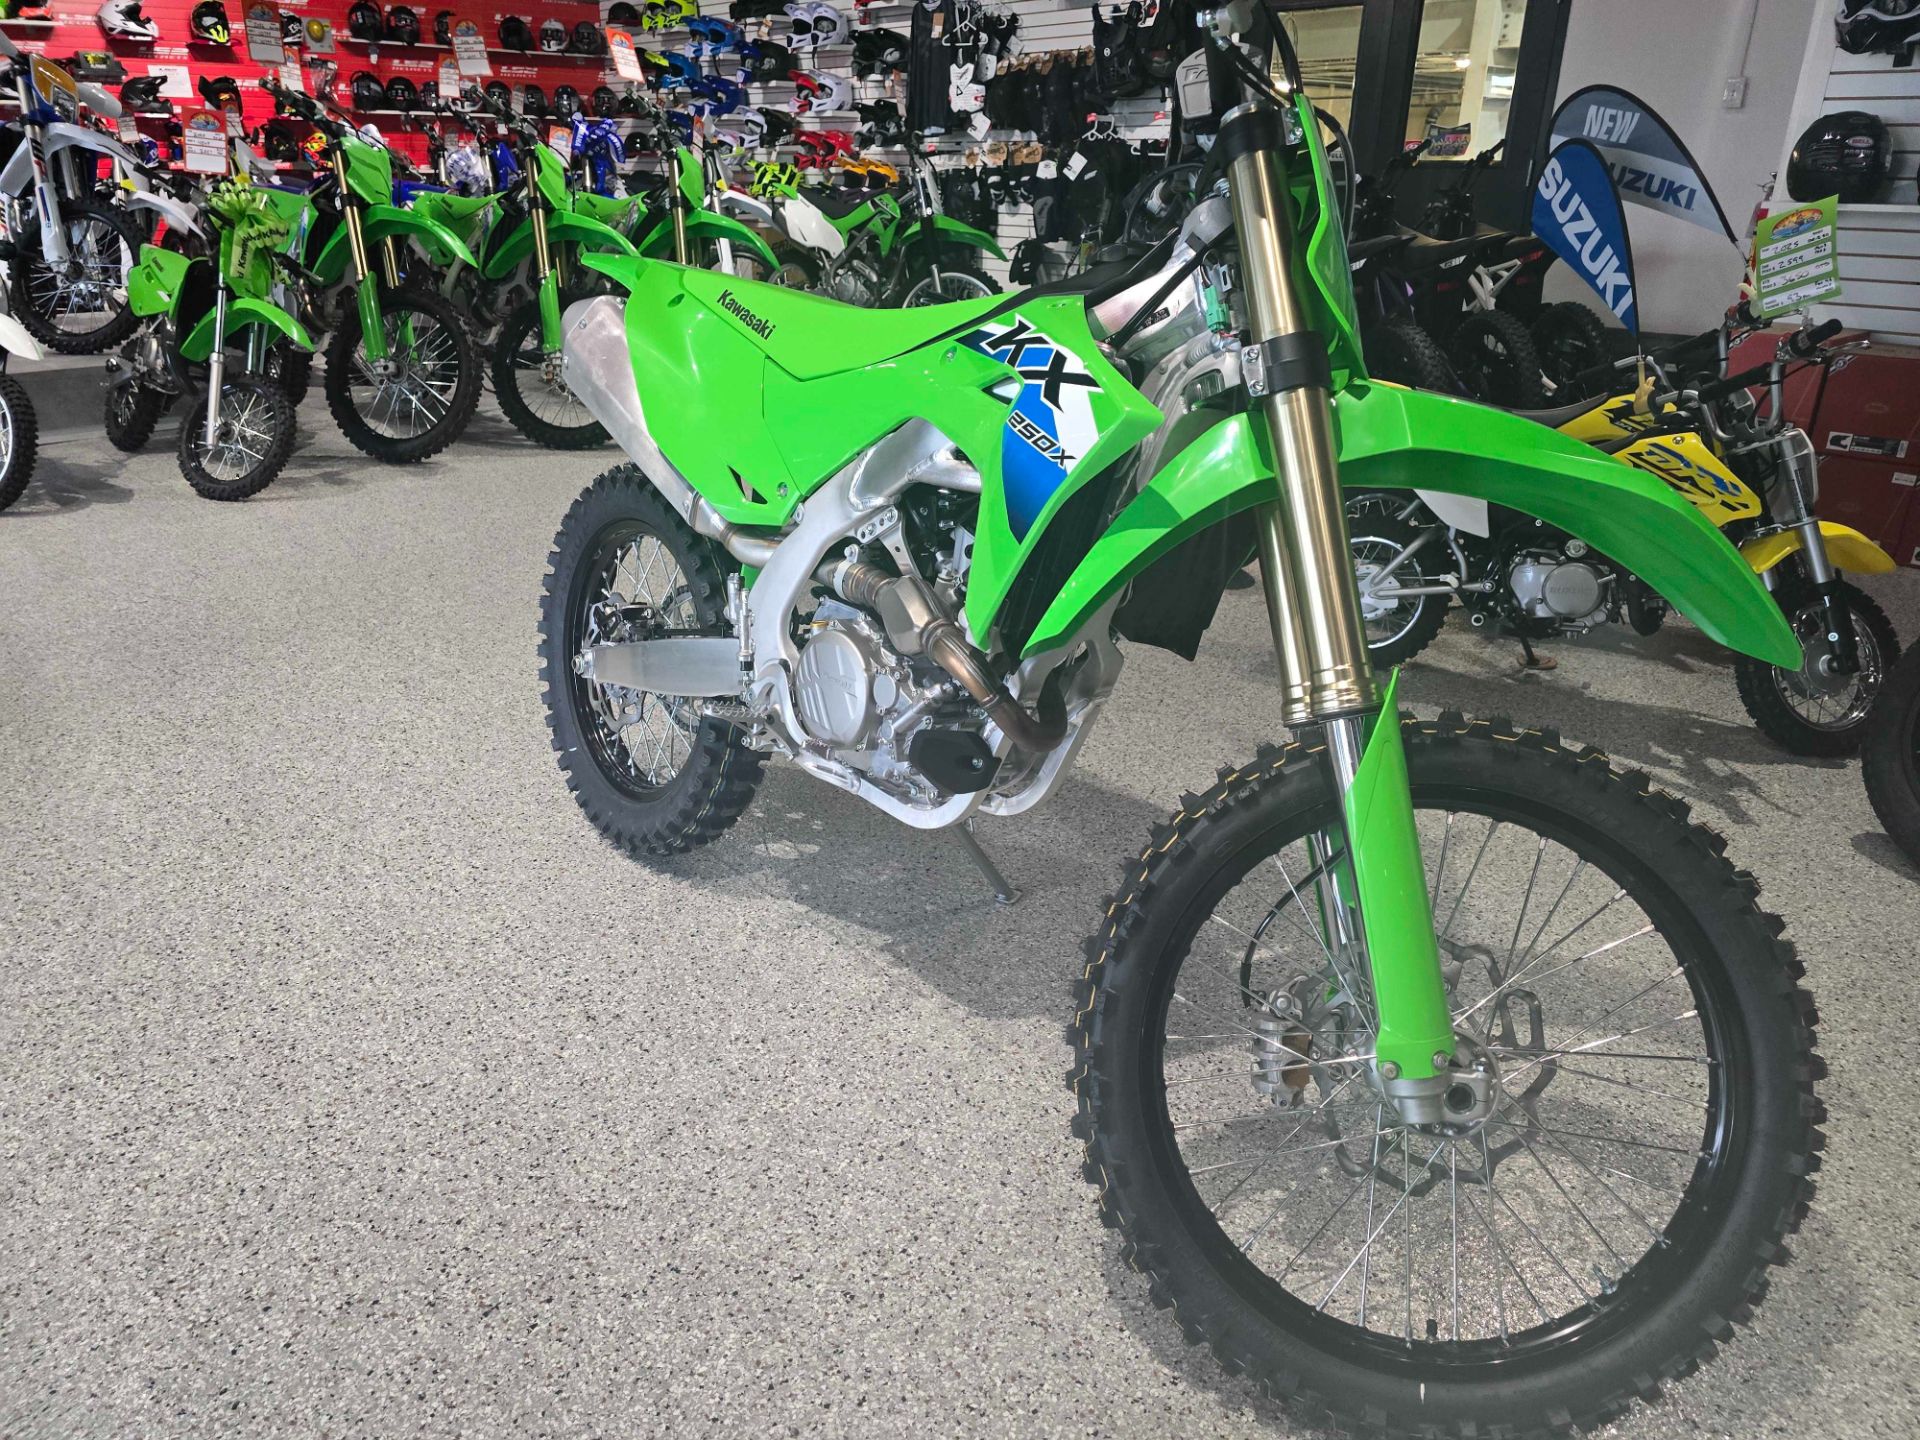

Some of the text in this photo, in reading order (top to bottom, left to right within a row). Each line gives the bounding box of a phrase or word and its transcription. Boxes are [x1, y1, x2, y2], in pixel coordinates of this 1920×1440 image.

[1582, 104, 1640, 144] NEW
[1609, 162, 1697, 211] UZUKI
[1538, 157, 1634, 319] SUZUKI
[717, 289, 777, 341] Kawasaki
[984, 319, 1102, 414] KX
[1007, 411, 1078, 468] 250X
